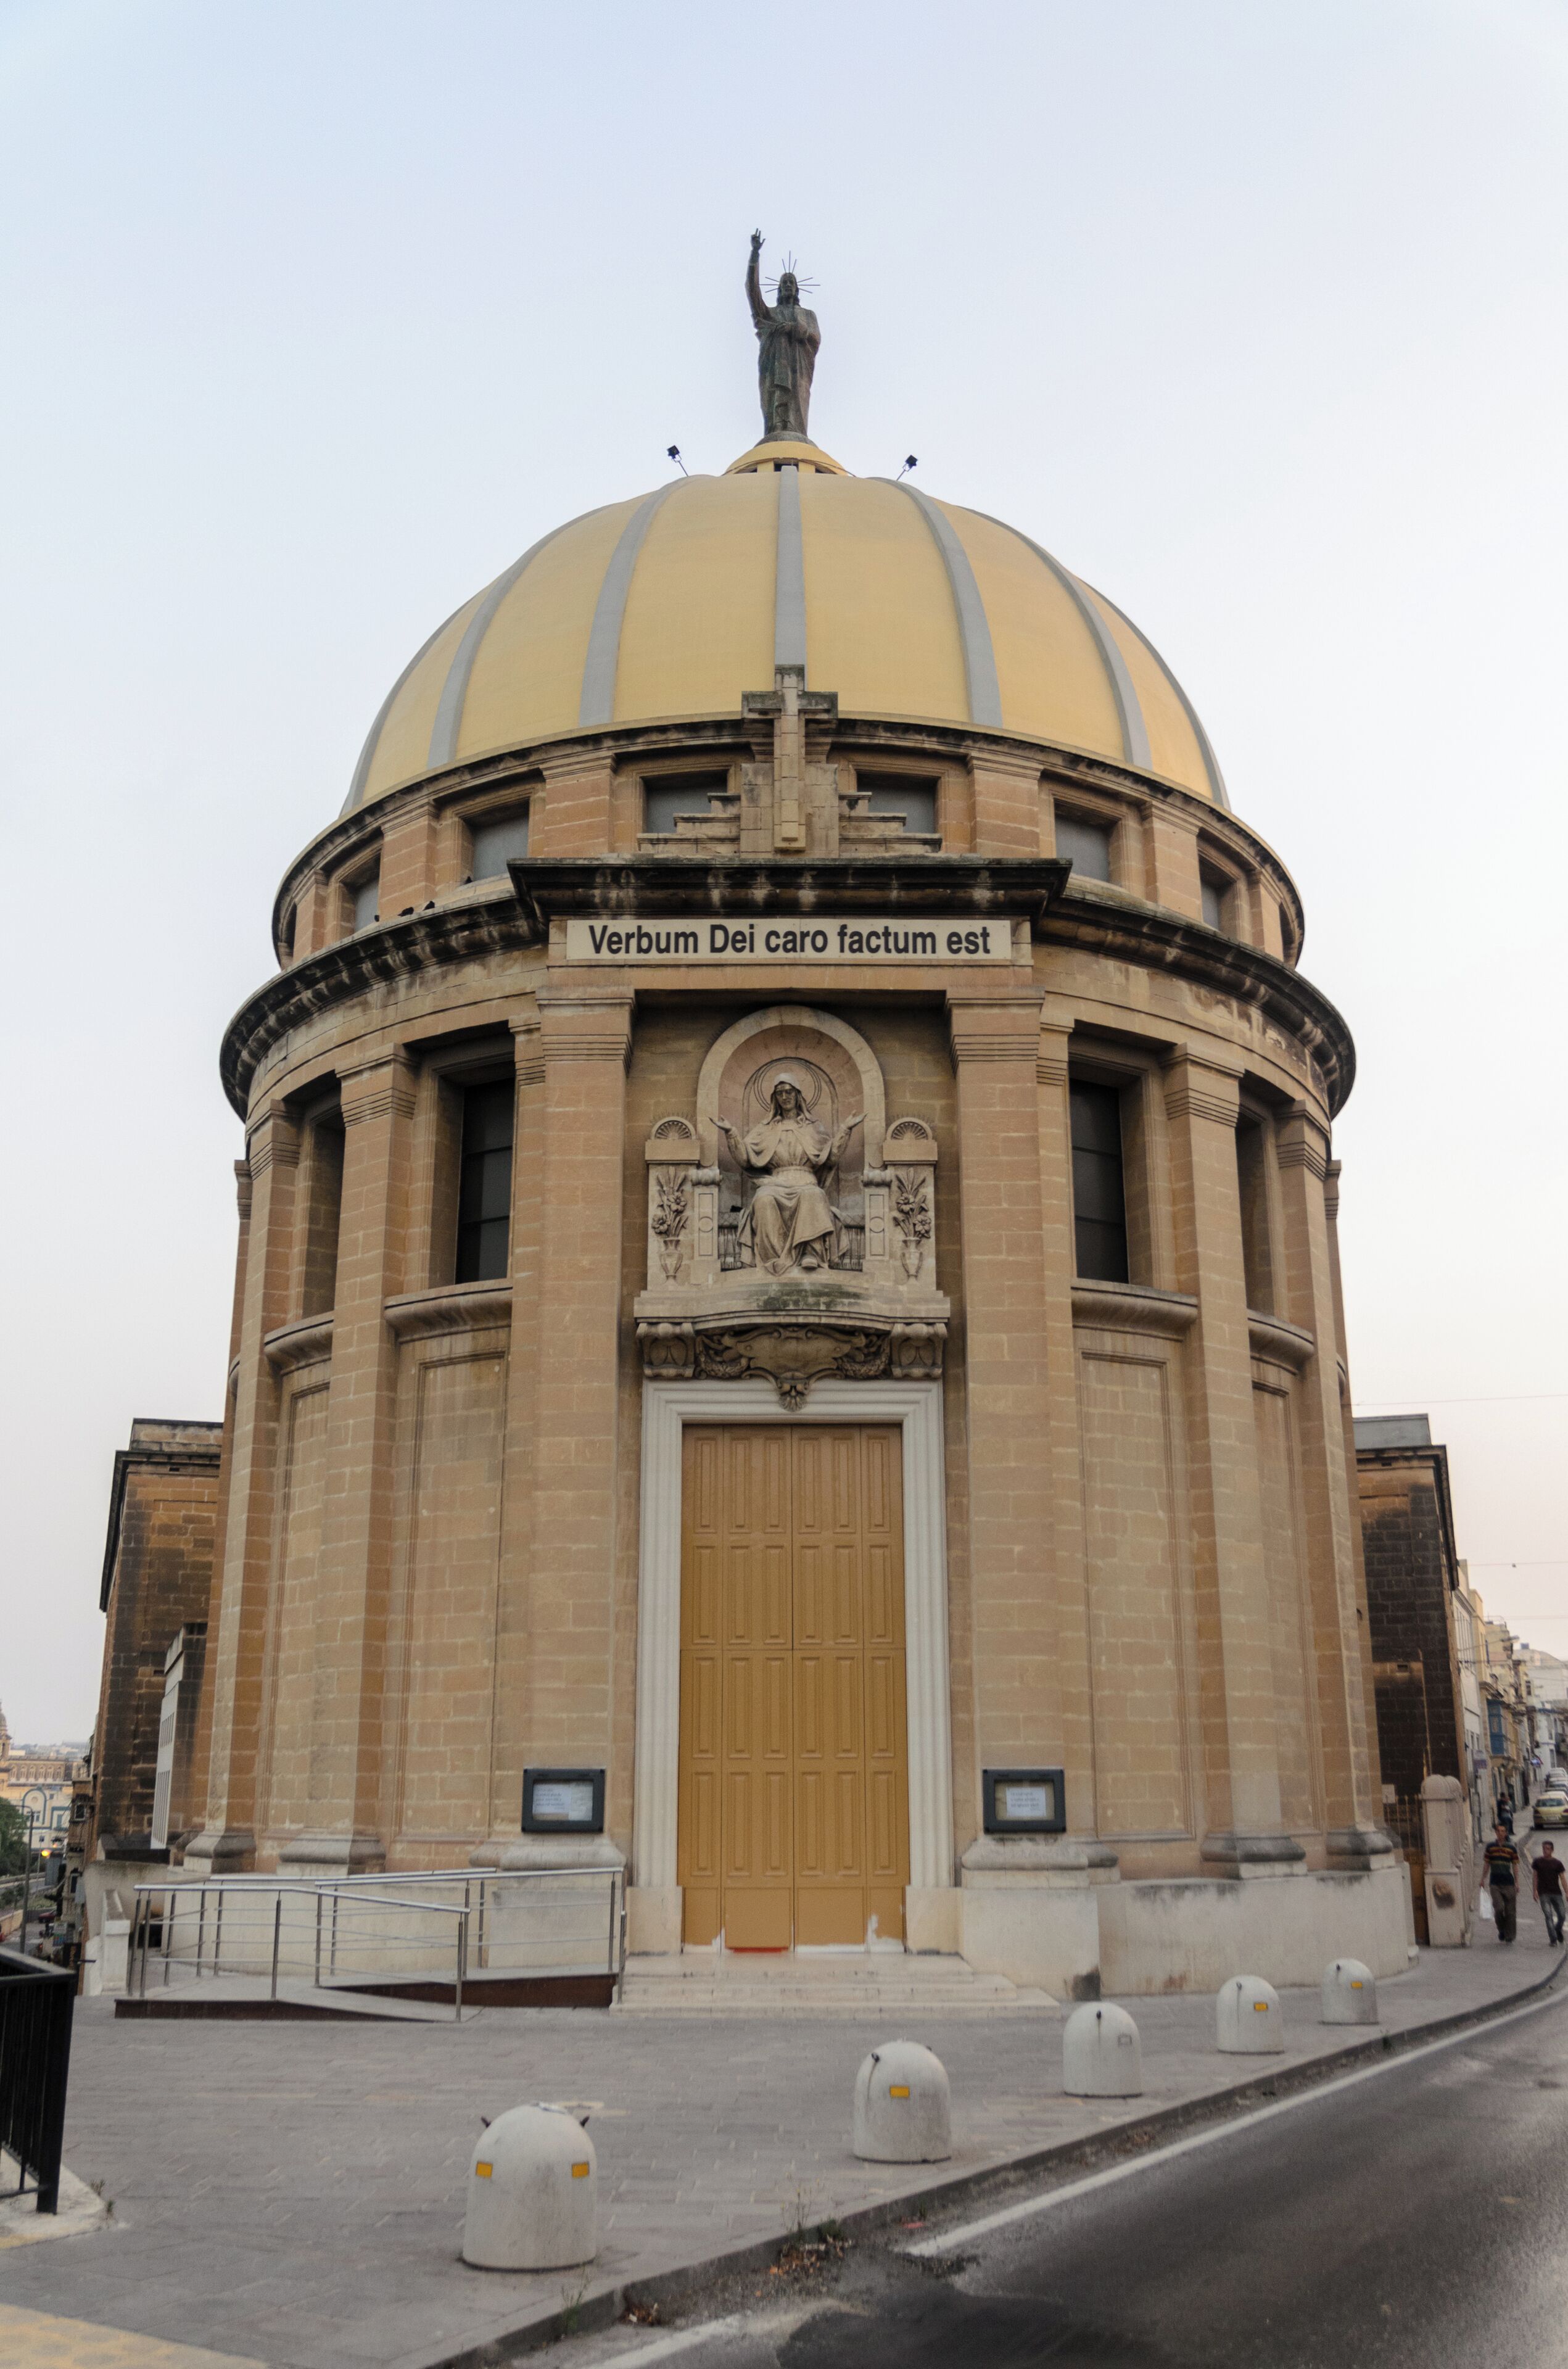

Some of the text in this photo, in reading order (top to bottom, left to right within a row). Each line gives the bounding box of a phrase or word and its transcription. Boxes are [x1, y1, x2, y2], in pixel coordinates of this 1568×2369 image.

[588, 924, 991, 954] Verbum Dei caro factum est
